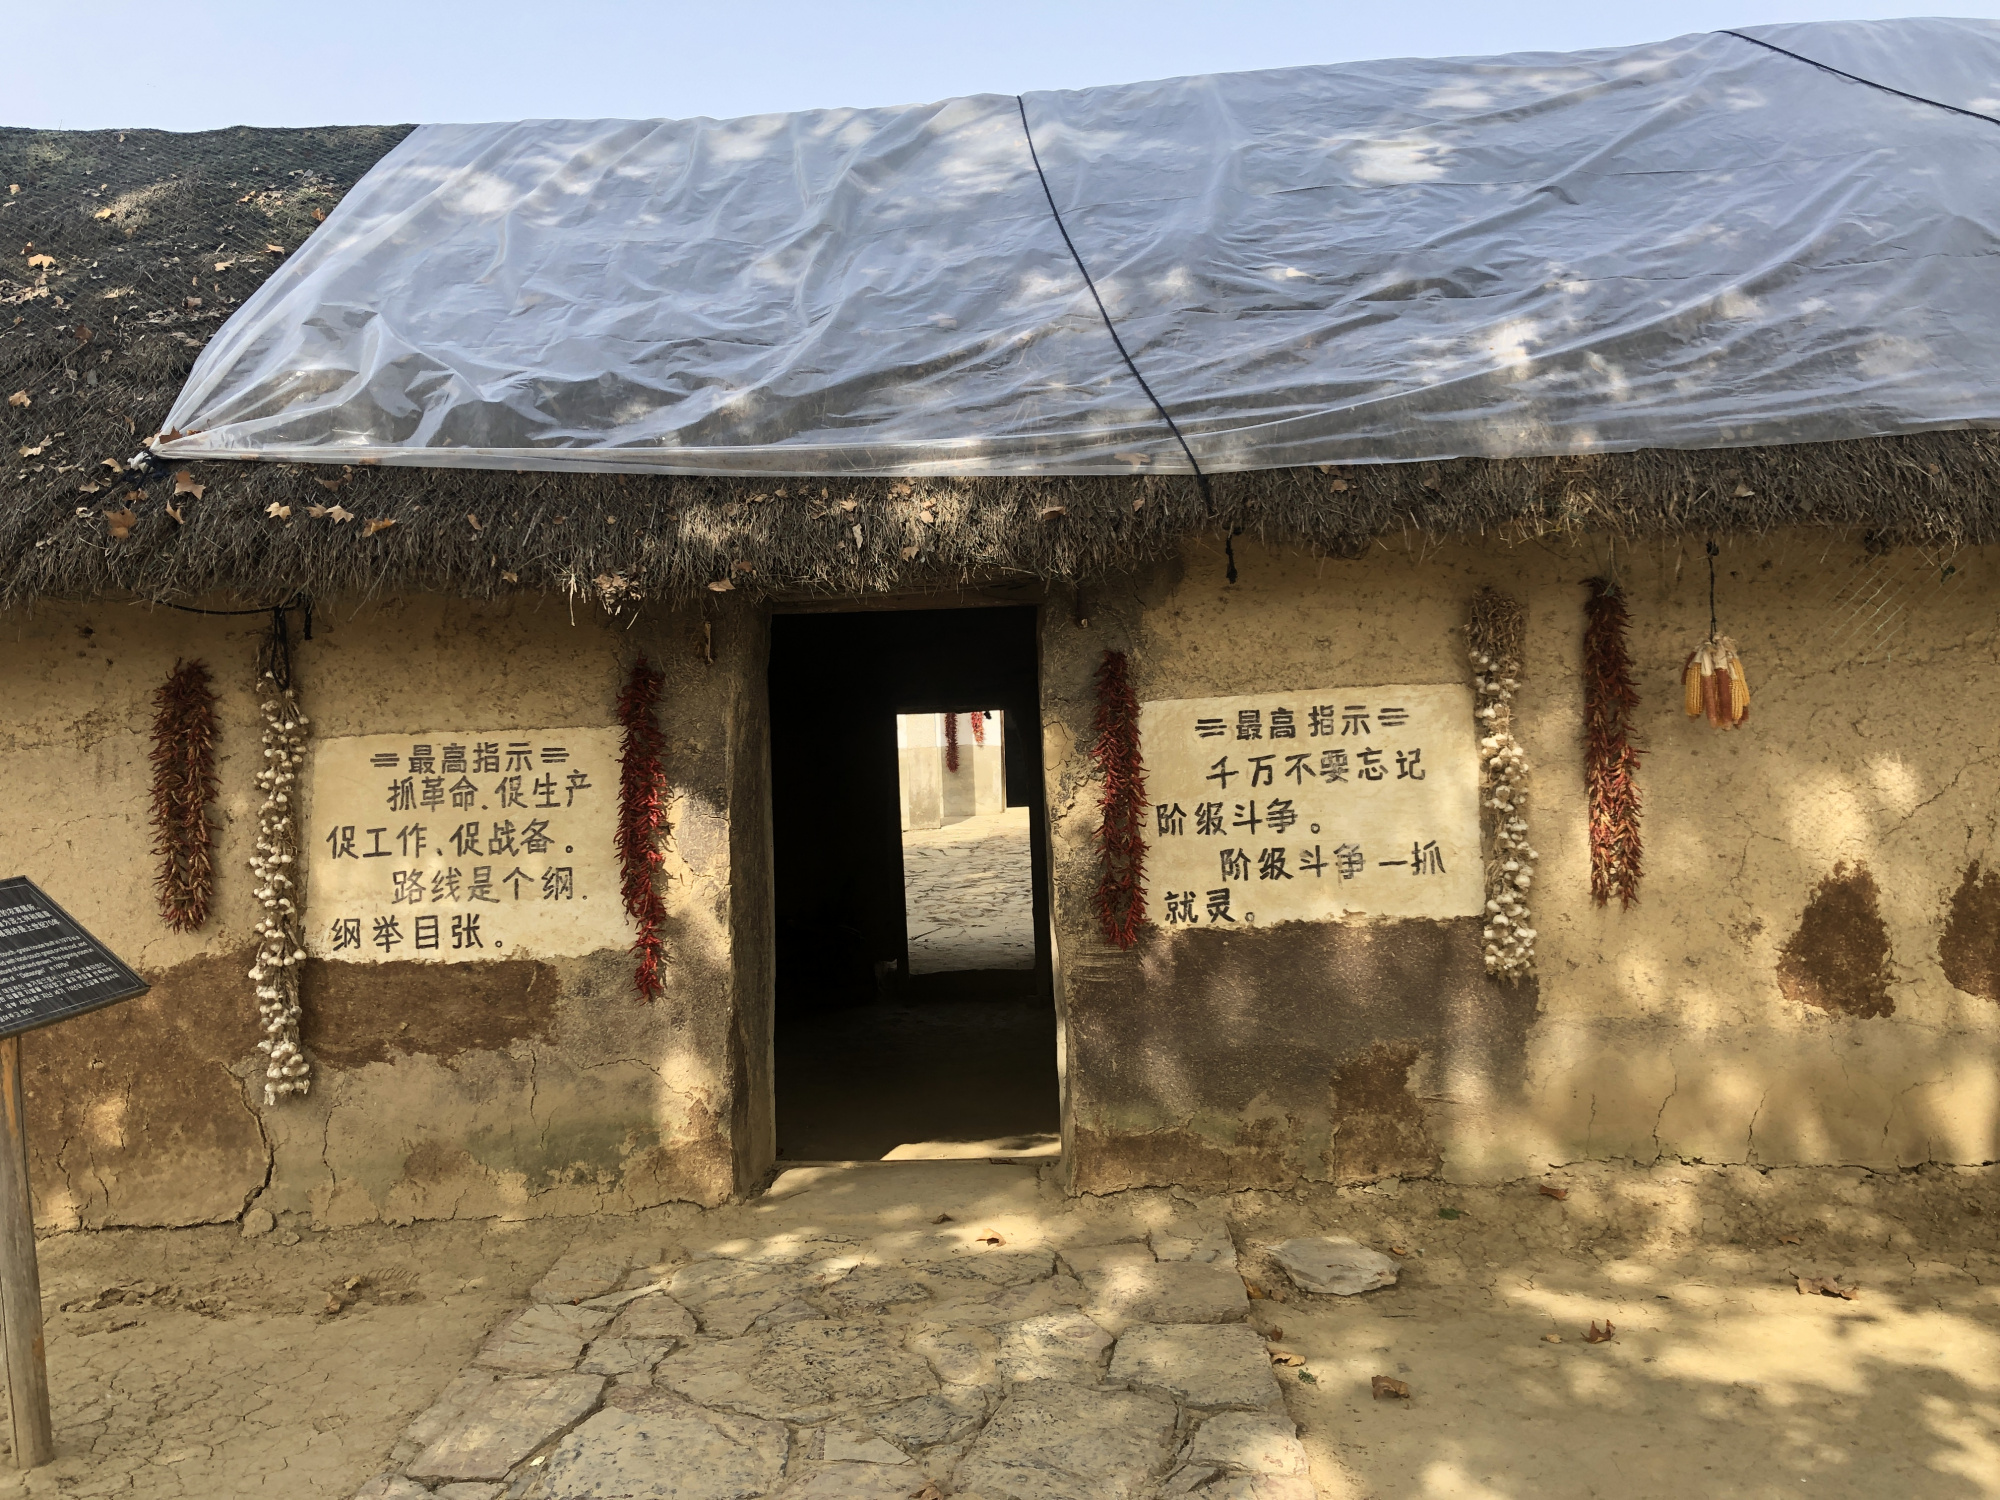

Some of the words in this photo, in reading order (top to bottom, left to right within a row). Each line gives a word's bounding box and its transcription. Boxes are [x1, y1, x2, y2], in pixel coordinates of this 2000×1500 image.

[1206, 747, 1426, 789] 千万不要忘记
[1220, 839, 1447, 884] 阶级斗争一抓
